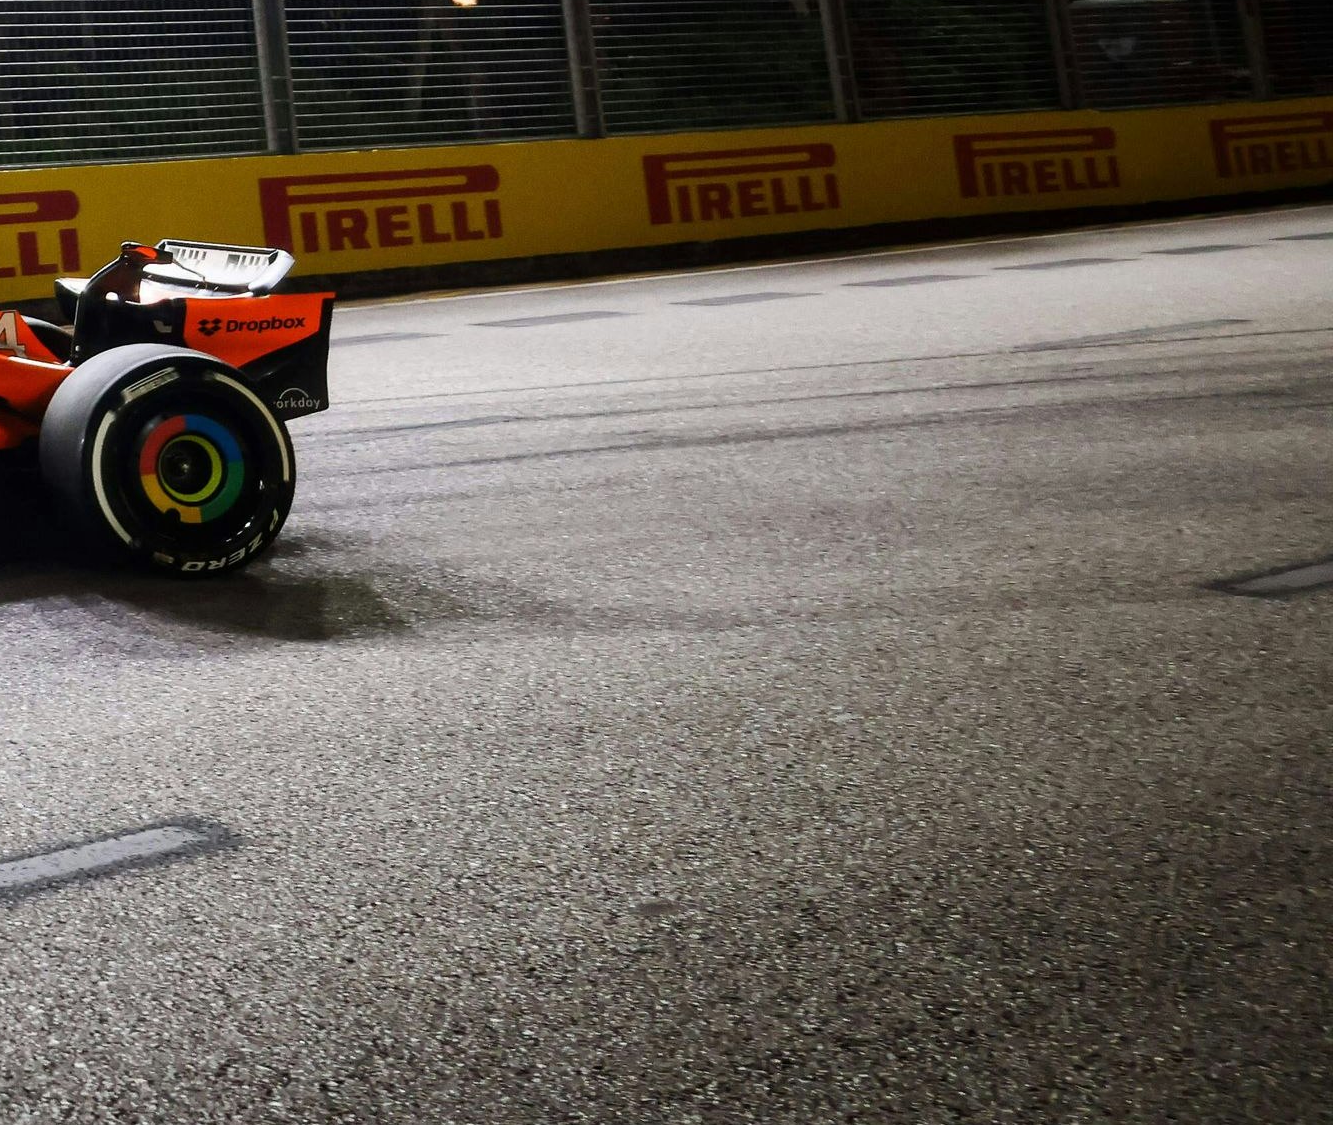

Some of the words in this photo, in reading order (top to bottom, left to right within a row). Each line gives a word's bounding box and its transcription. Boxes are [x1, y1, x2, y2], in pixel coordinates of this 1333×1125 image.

[642, 142, 841, 225] PIRELLI
[954, 127, 1120, 199] PIRELLI
[258, 165, 503, 253] PIRELLI
[226, 316, 306, 333] Dropbox
[274, 396, 320, 409] orkday
[181, 532, 263, 571] ZERO
